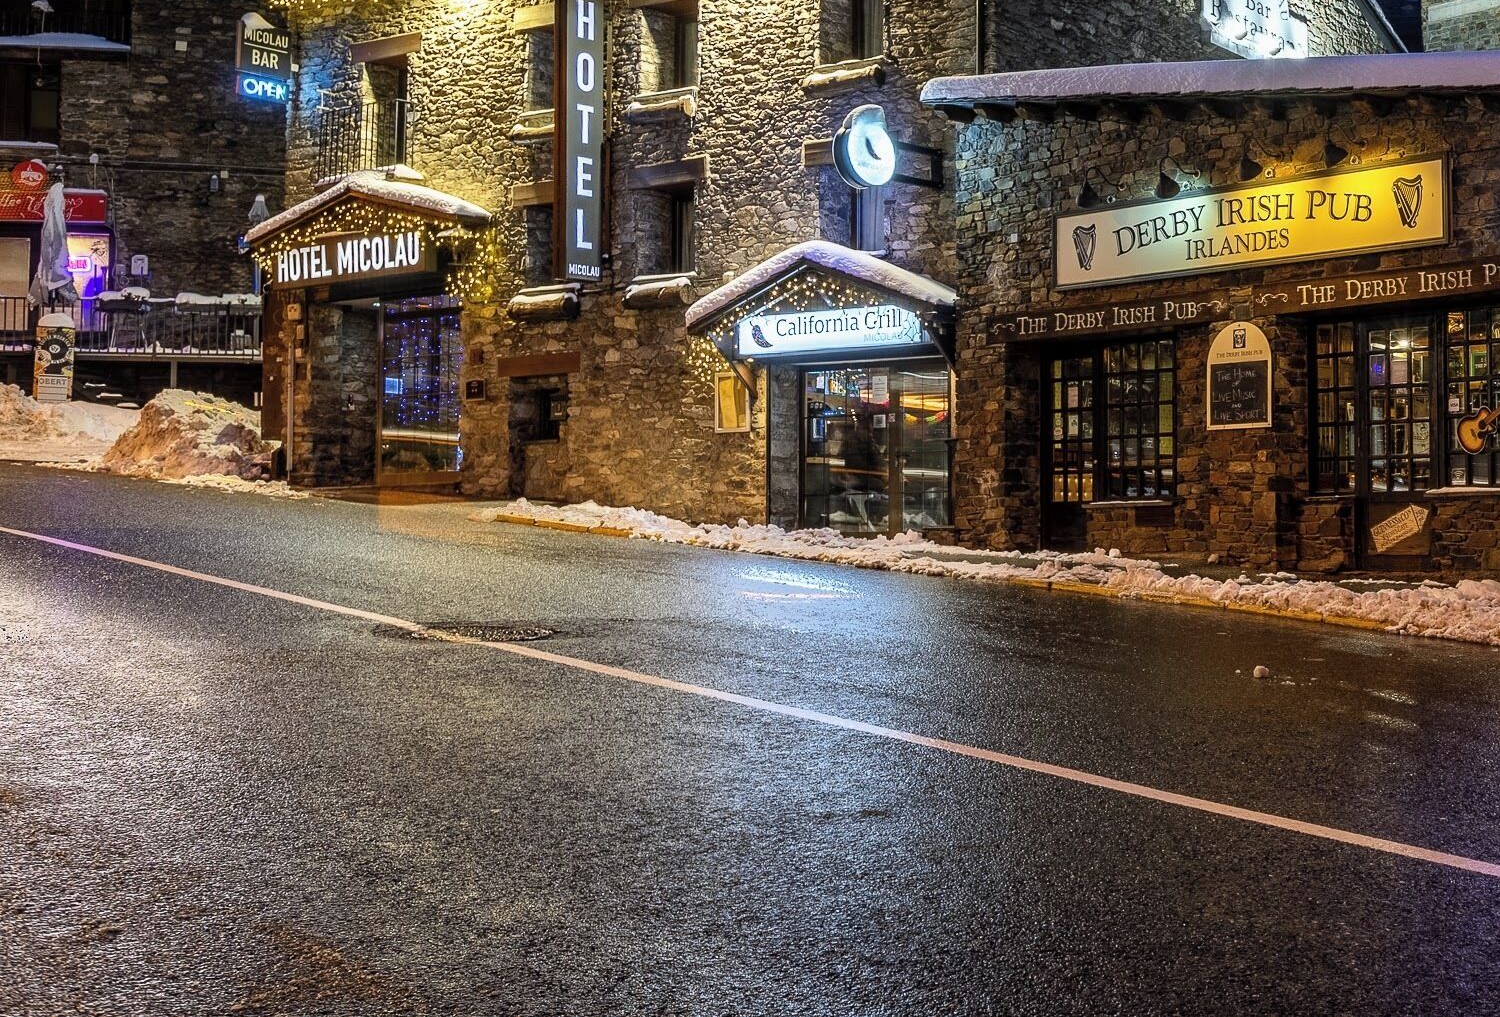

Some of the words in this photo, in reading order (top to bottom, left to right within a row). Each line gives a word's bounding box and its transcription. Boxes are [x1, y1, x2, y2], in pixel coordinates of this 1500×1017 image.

[243, 29, 289, 49] MICOLAU
[251, 49, 279, 70] BAR
[243, 78, 287, 101] OPEN
[1112, 204, 1206, 257] DERBY
[1213, 193, 1295, 228] IRISH
[1305, 190, 1373, 222] PUB
[1185, 228, 1290, 261] IRLANDES
[277, 244, 333, 283] HOTEL
[337, 231, 420, 276] MICOLAU
[568, 263, 600, 277] MICOLAU
[1296, 285, 1336, 306] THE
[1344, 276, 1409, 301] DERBY
[1418, 269, 1473, 293] IRISH
[776, 314, 859, 337] California
[864, 308, 902, 330] Grill
[1017, 316, 1048, 335] THE
[1054, 311, 1105, 332] DERBY
[1112, 305, 1156, 326] IRISH
[1163, 301, 1198, 321] PUB
[863, 332, 903, 343] MICOLAU
[38, 377, 67, 386] OBERT
[1216, 370, 1232, 382] THE
[1212, 391, 1232, 403] LIVE
[1214, 410, 1232, 421] LIVE
